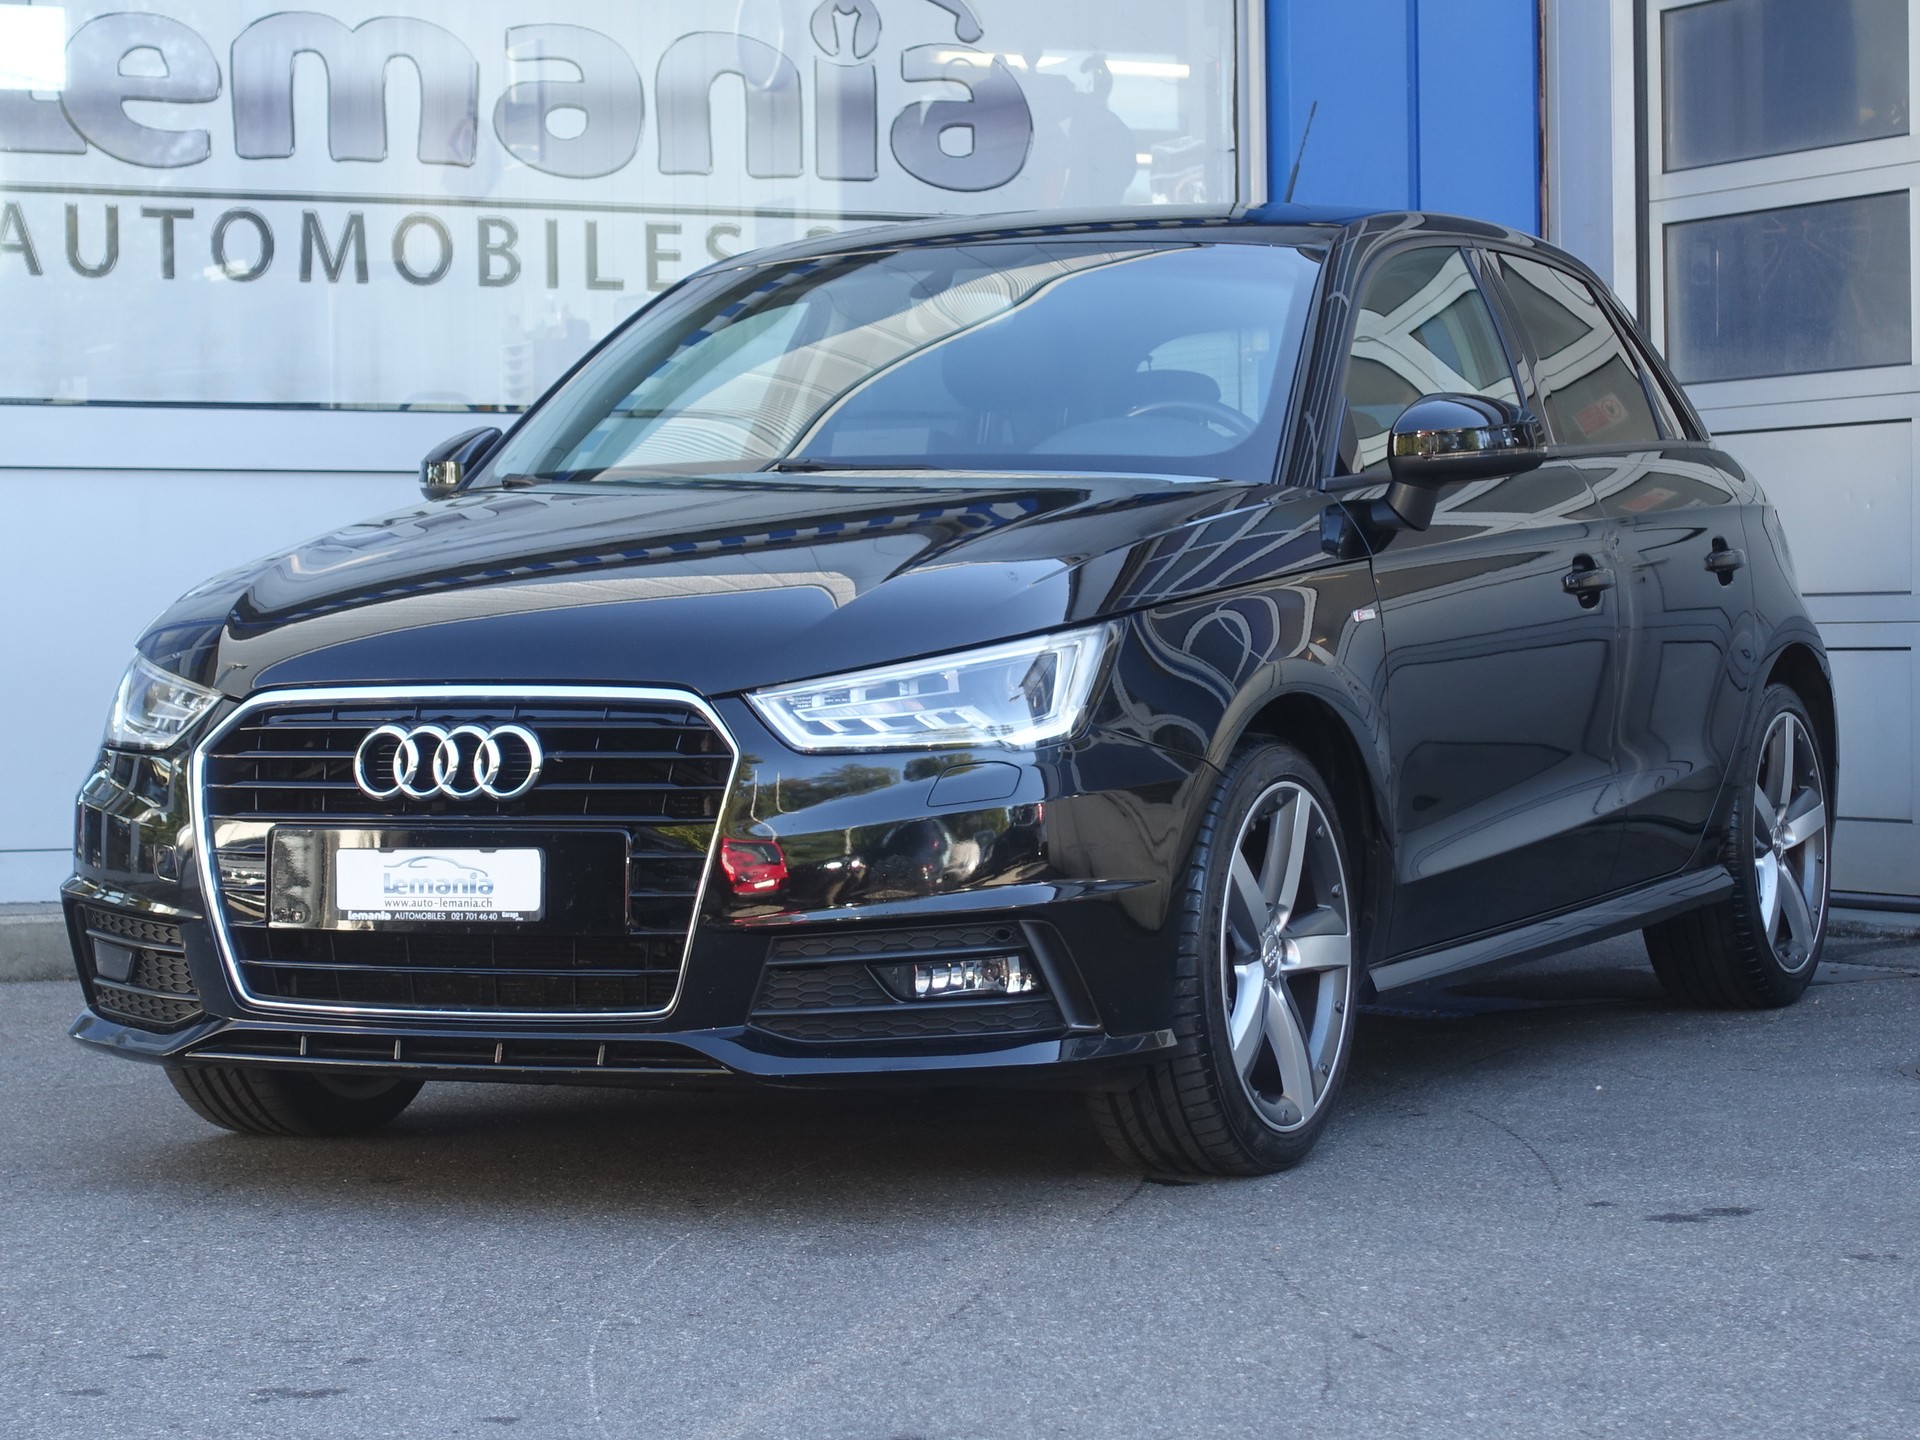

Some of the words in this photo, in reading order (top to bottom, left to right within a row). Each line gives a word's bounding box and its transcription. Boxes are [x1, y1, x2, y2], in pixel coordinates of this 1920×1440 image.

[383, 872, 494, 895] Lemania
[384, 897, 493, 908] www.auto-lemania.ch
[394, 912, 446, 920] AUTOMOBILES
[465, 912, 477, 920] 701
[478, 912, 488, 920] 46
[488, 912, 498, 920] 40
